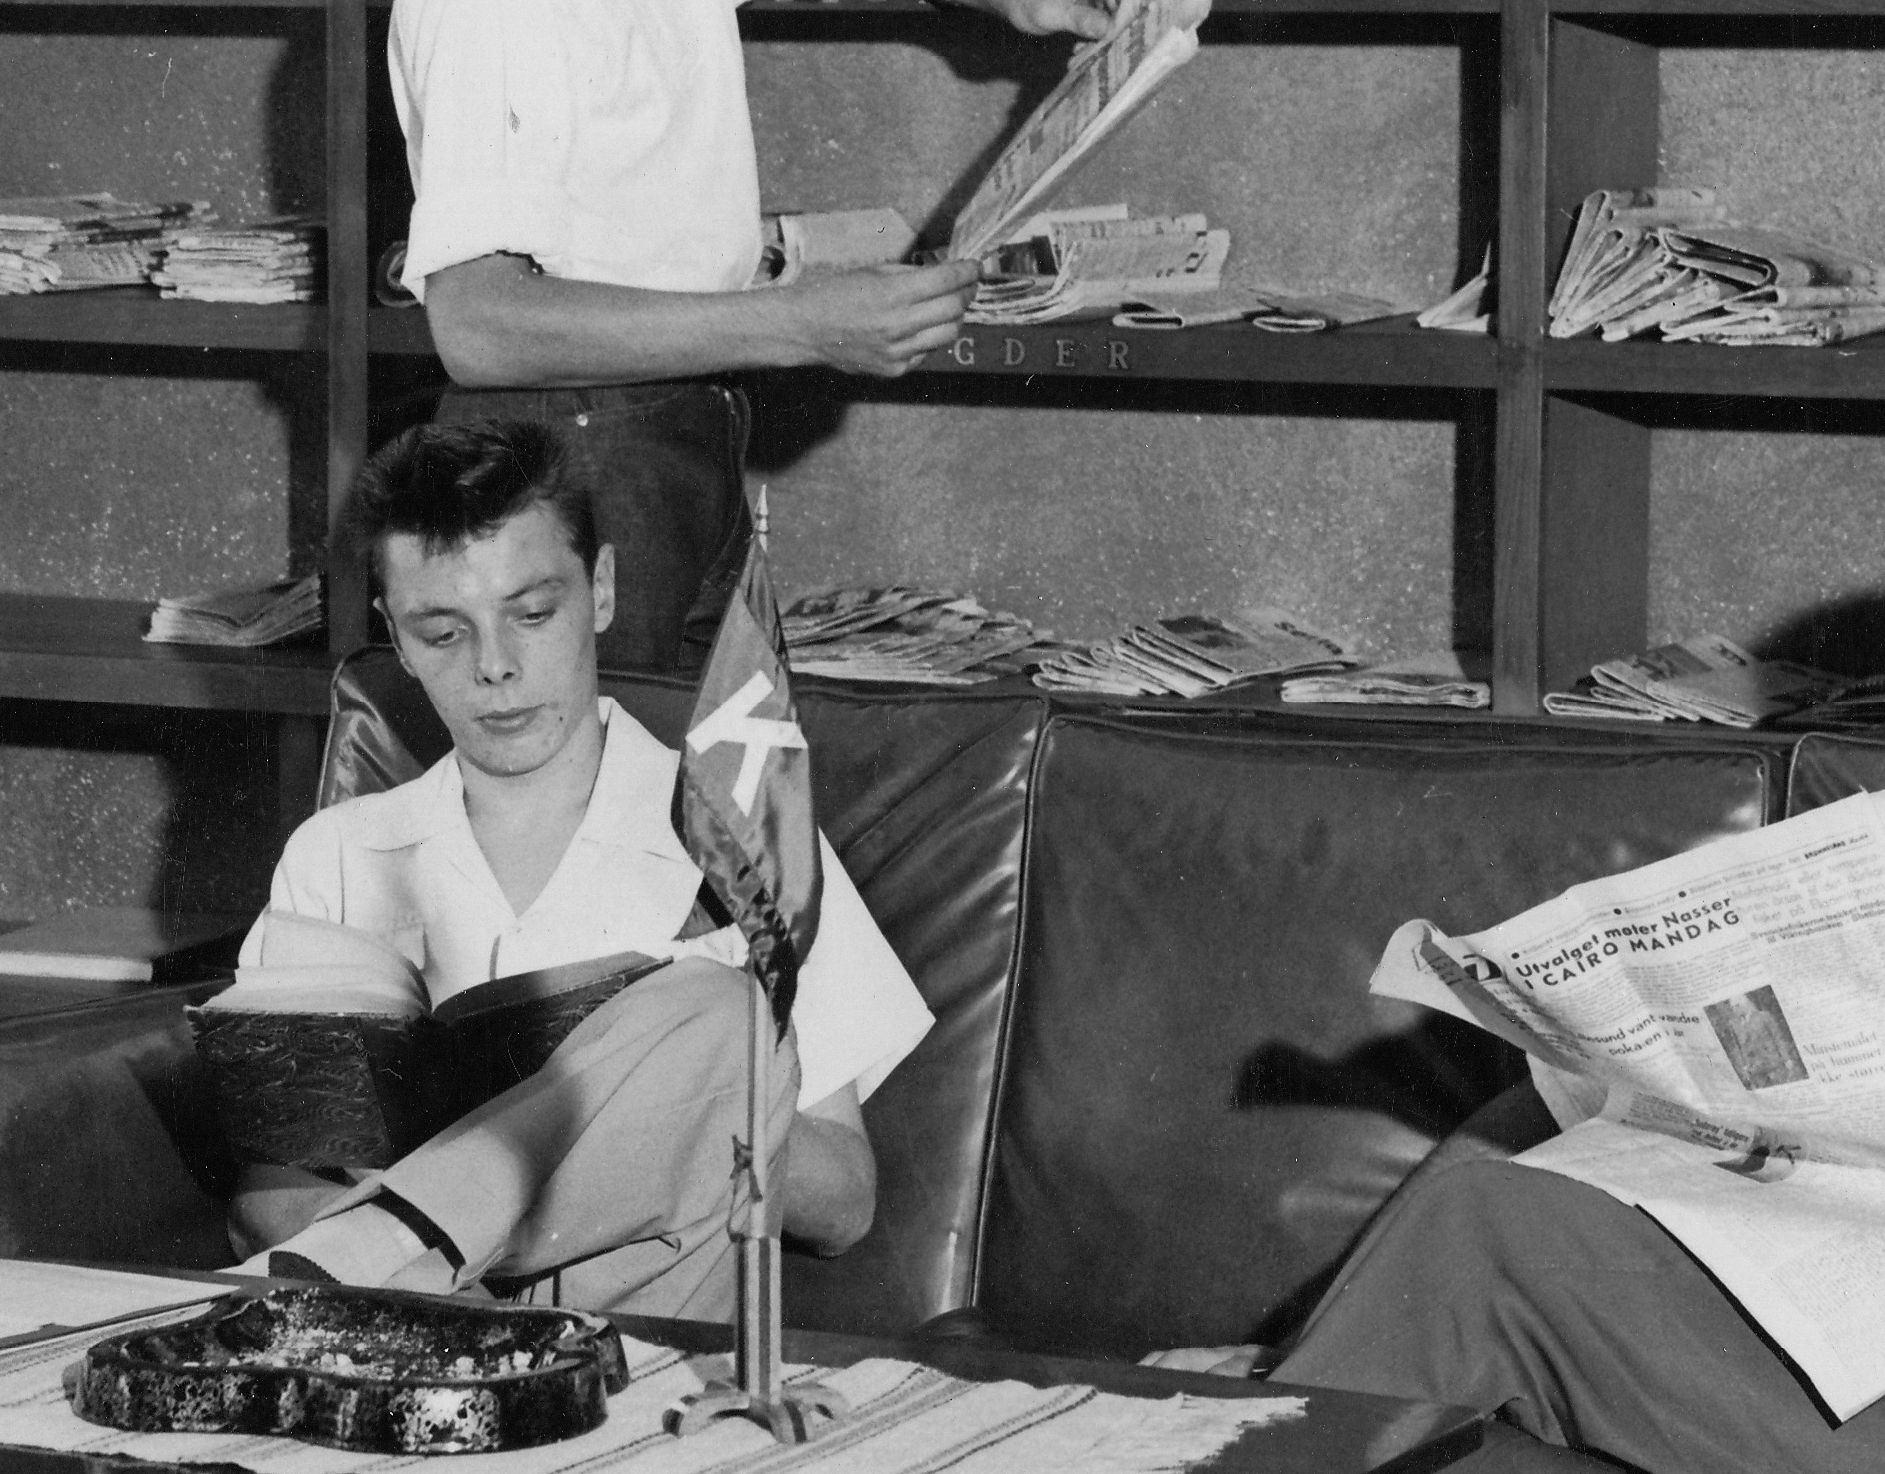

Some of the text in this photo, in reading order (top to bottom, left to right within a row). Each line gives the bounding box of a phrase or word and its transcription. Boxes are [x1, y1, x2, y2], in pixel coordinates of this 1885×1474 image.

[953, 336, 1129, 369] GDER
[1516, 934, 1600, 977] Utvalget
[1662, 897, 1731, 928] Nasser
[1524, 979, 1535, 990] I
[1543, 941, 1619, 986] CAIRO
[1629, 910, 1740, 952] MANDAG
[1627, 1014, 1657, 1035] vant
